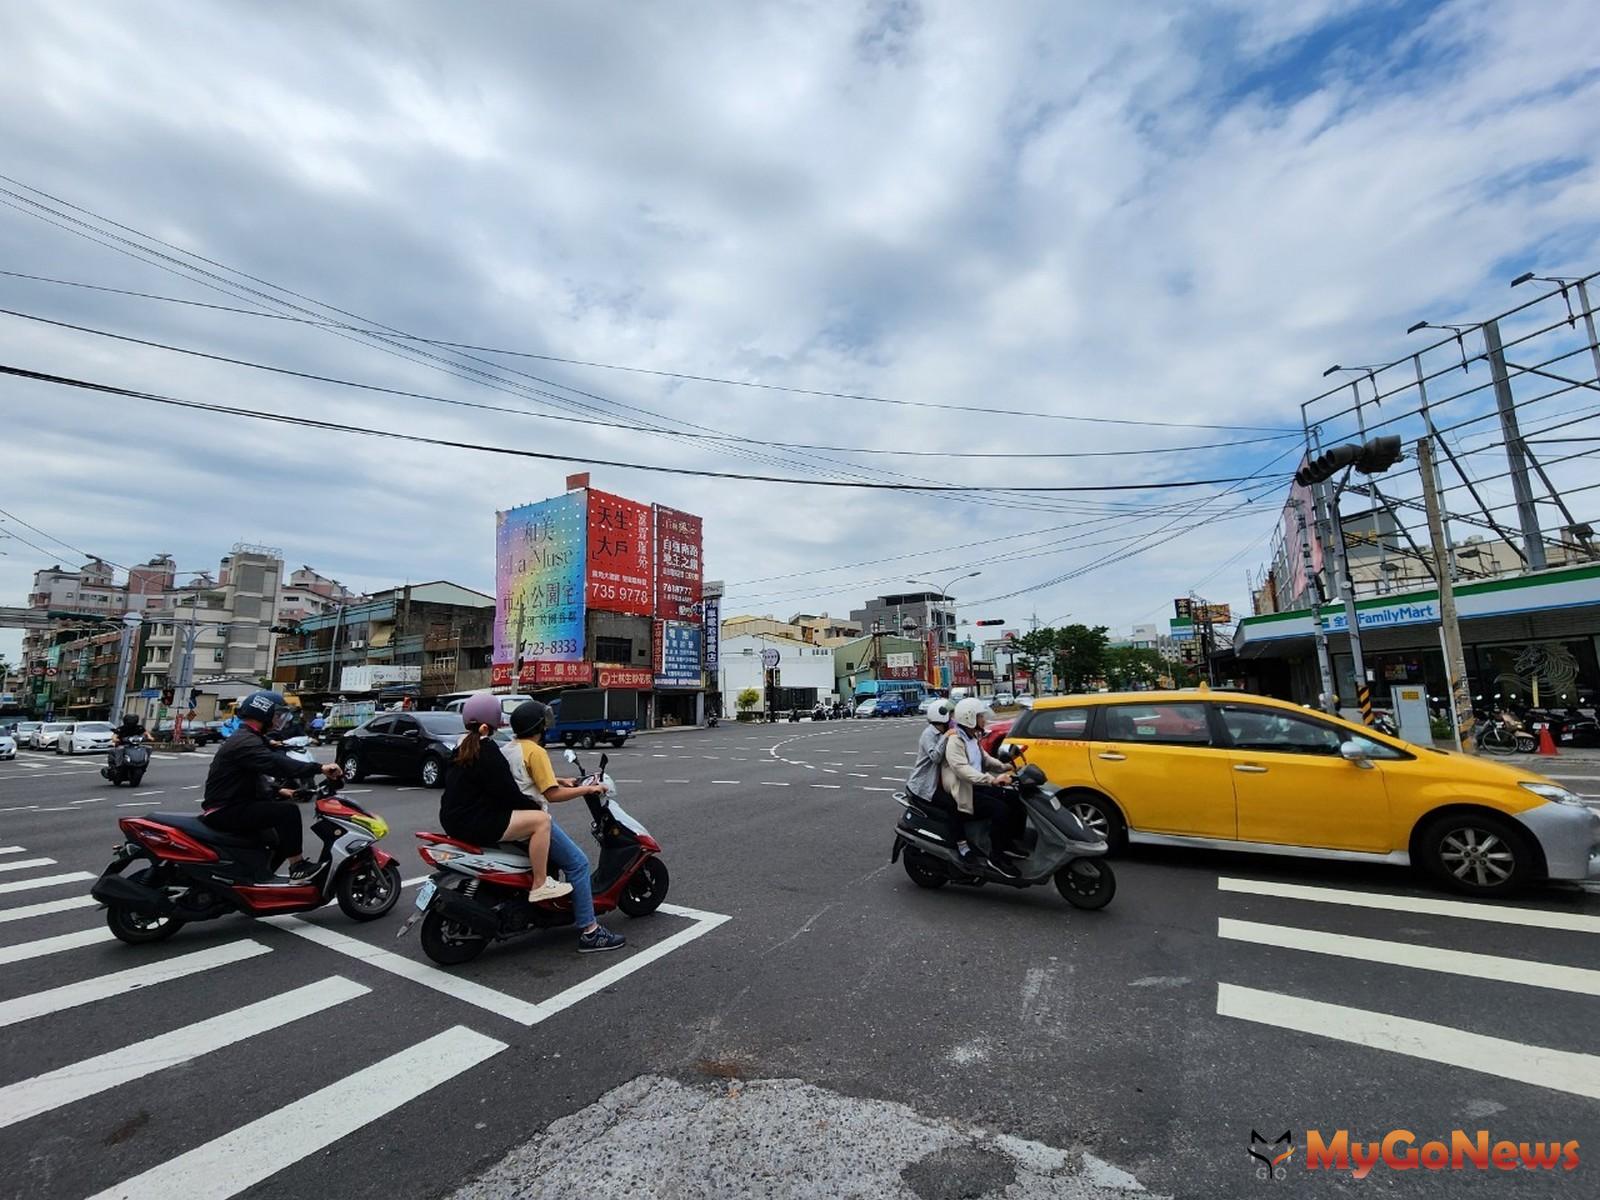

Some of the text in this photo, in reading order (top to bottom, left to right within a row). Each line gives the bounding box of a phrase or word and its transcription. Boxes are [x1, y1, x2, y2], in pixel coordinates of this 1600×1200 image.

[591, 583, 615, 599] 735
[619, 587, 648, 604] 9778
[1358, 605, 1433, 625] FamilyMart
[526, 639, 577, 656] 723-8333
